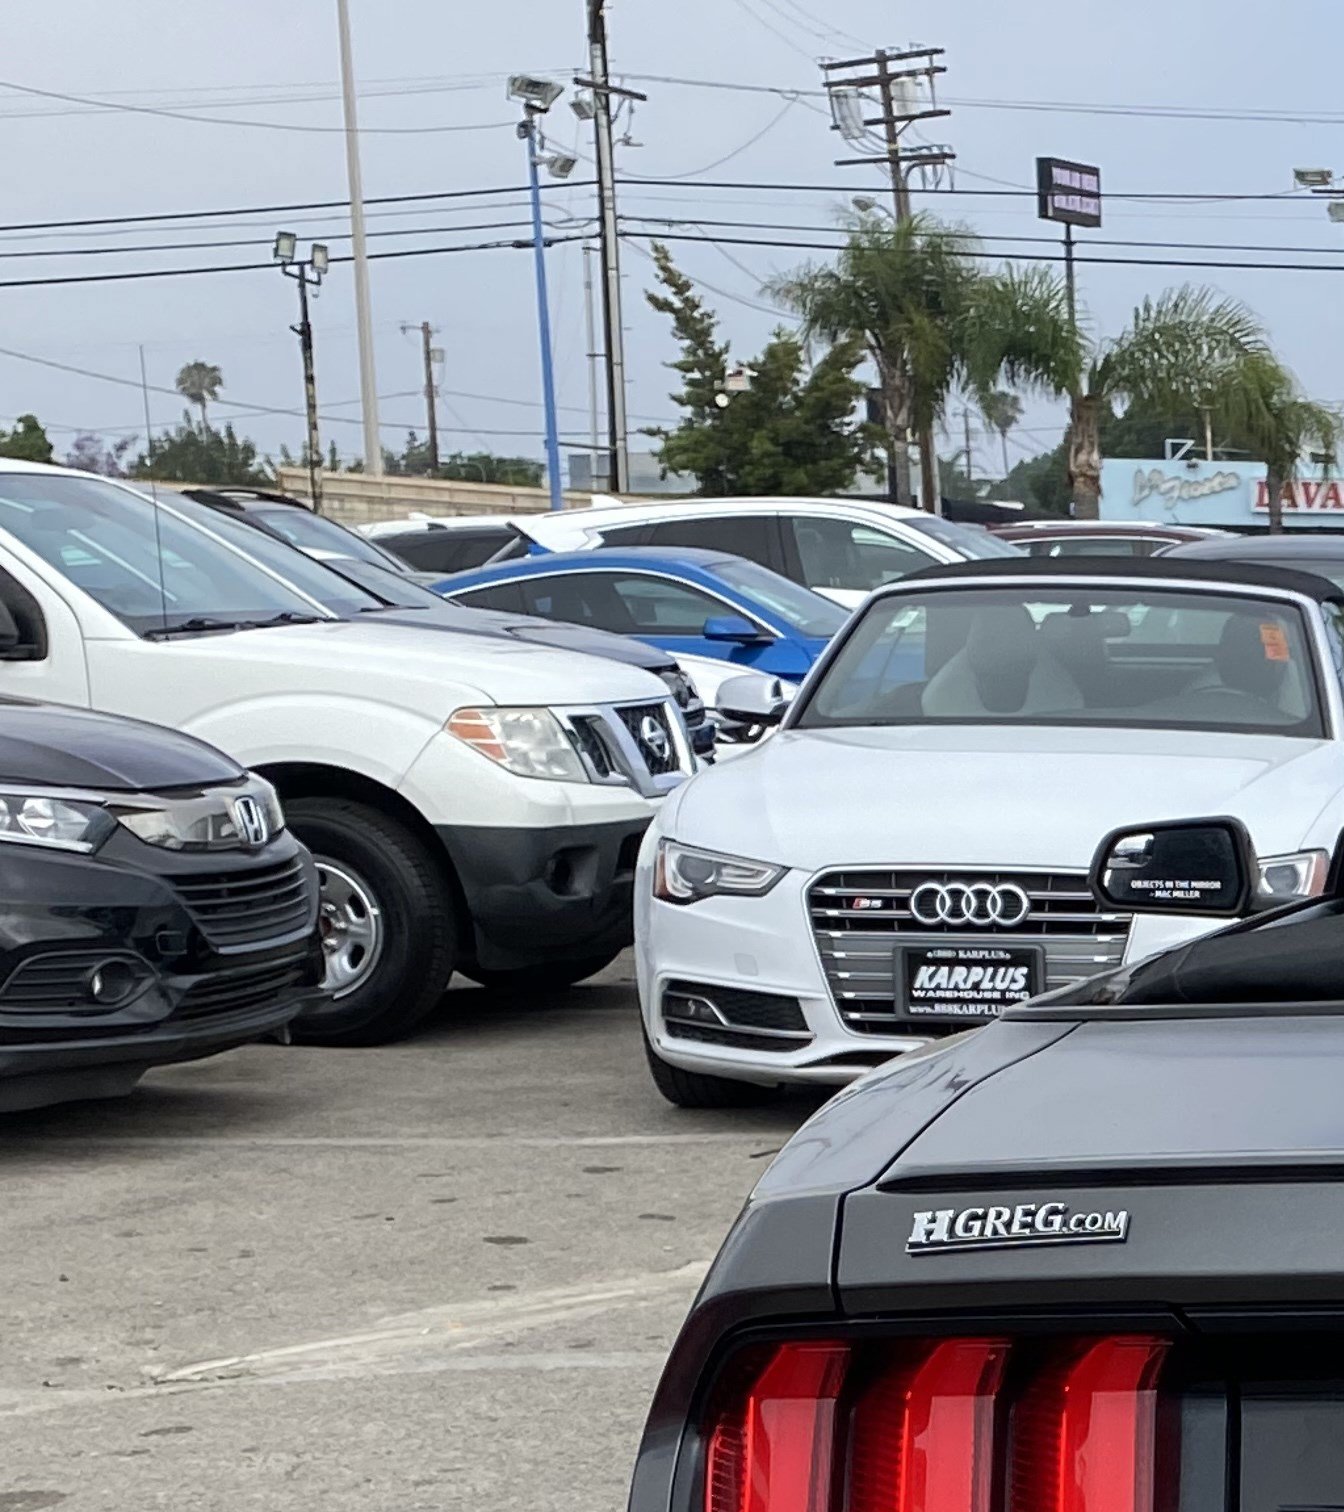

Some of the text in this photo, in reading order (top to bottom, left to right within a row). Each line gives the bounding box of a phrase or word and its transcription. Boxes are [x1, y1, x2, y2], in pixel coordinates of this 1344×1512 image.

[913, 966, 1029, 990] KARPLUS
[912, 989, 1030, 1000] WAREHOUSE INC
